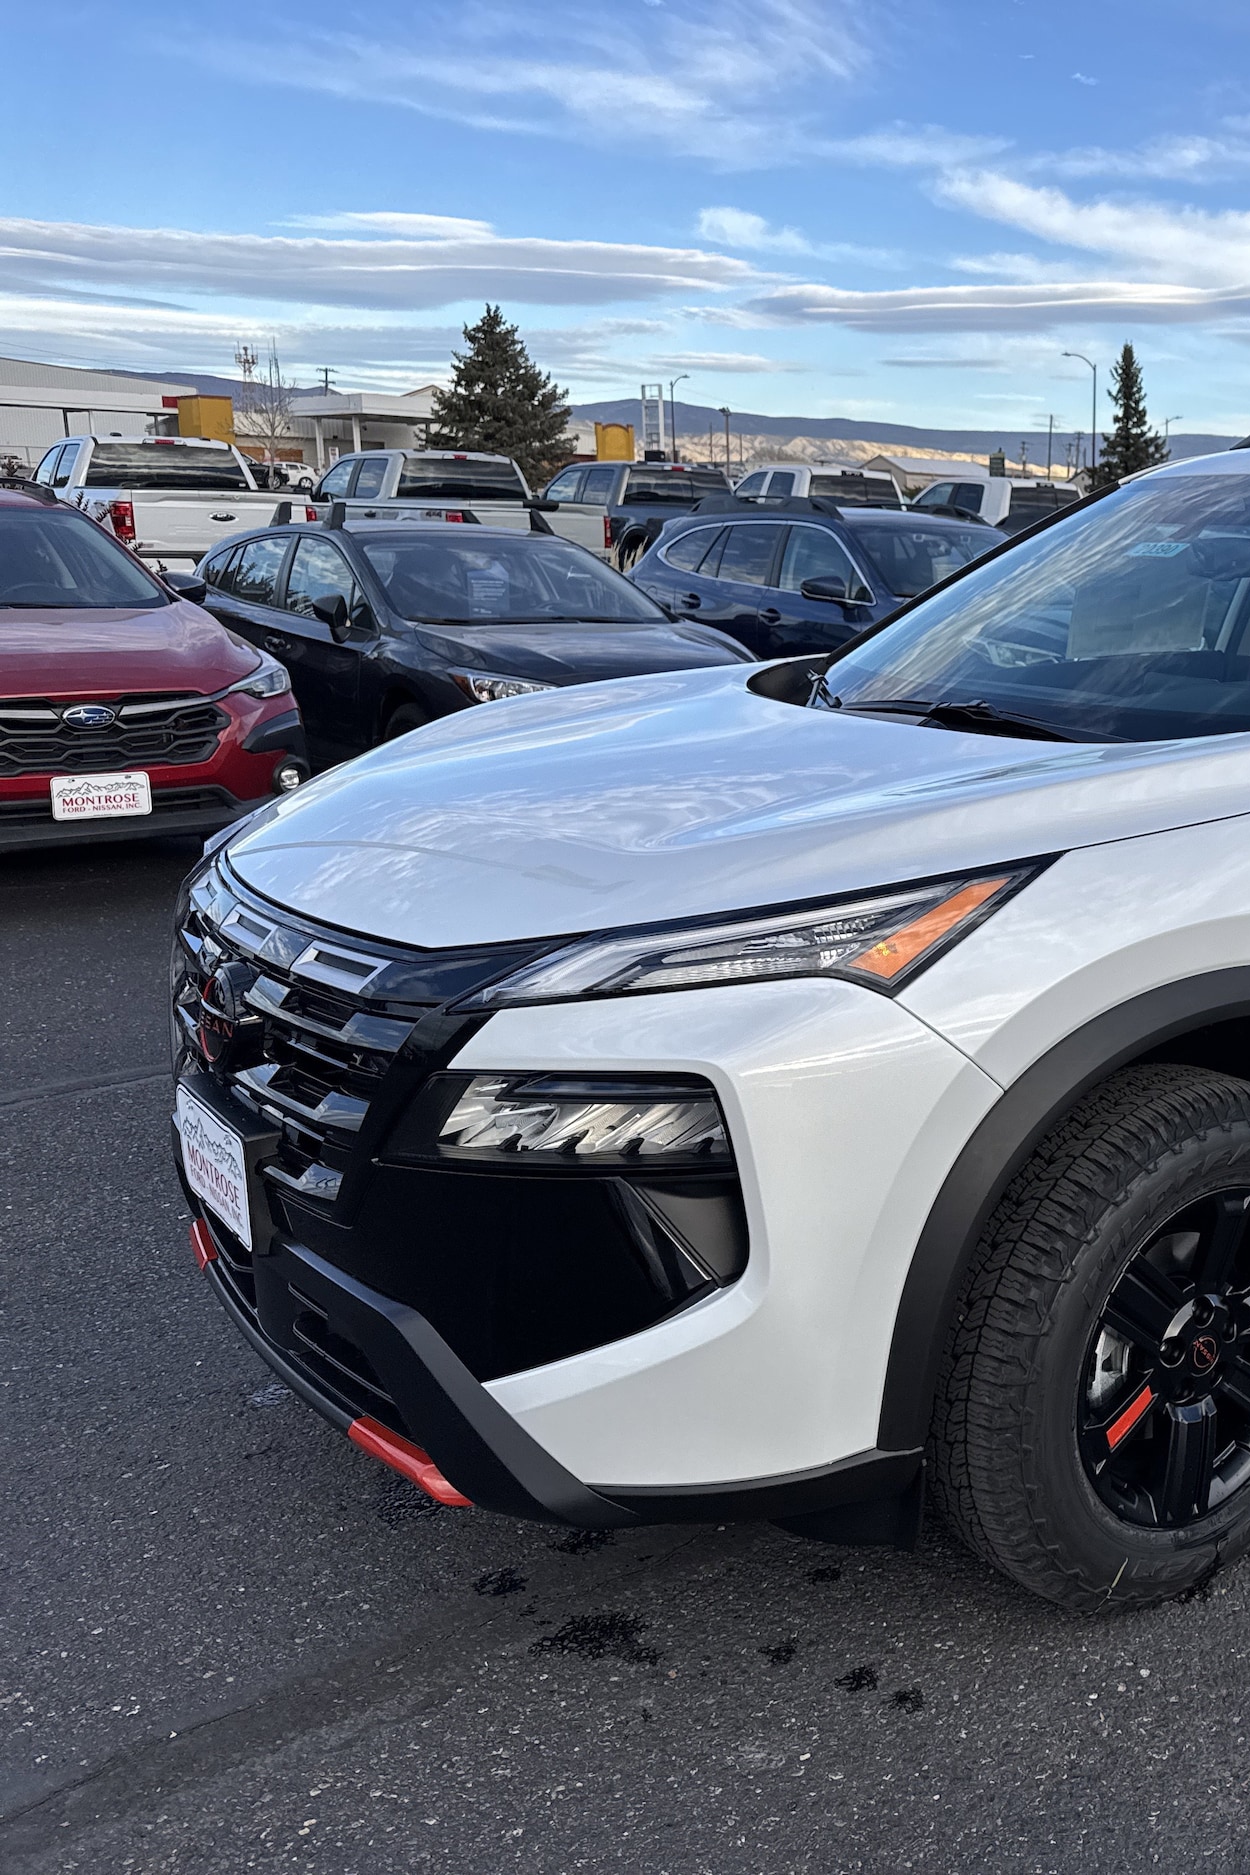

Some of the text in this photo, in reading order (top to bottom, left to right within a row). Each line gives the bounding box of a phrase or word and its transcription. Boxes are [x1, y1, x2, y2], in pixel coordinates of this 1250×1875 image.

[62, 793, 140, 807] MONTROSE
[62, 806, 86, 814] FORD
[92, 803, 125, 812] NISSAN,
[126, 802, 142, 810] INC.
[187, 1141, 241, 1210] MONTROSE
[190, 1164, 206, 1190] FORD
[209, 1183, 232, 1218] NISSAN,
[1193, 1340, 1215, 1364] NISSAN
